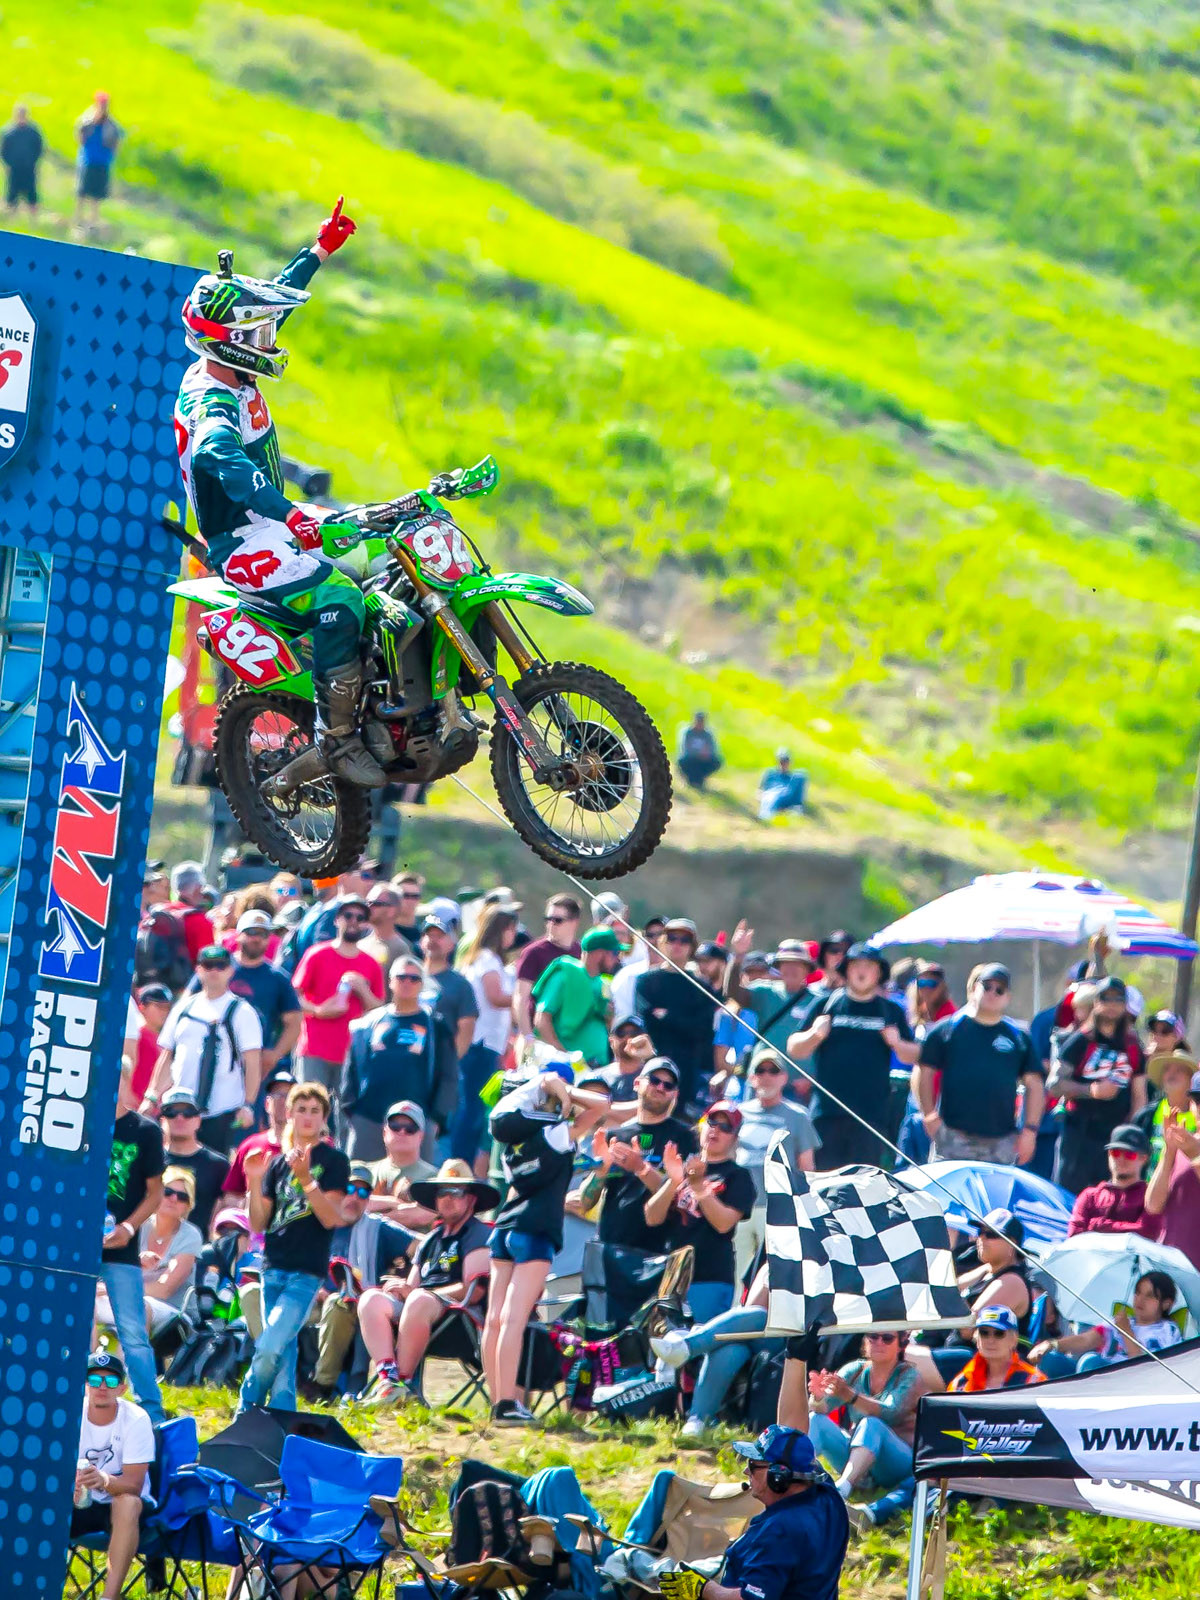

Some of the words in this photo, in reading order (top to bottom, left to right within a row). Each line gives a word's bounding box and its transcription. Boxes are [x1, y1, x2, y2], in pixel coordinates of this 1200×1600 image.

[219, 344, 256, 363] MONSTER
[218, 621, 279, 679] 92
[18, 989, 56, 1144] RACING
[41, 993, 98, 1152] PRO
[967, 1419, 1044, 1438] Thunder
[976, 1437, 1033, 1456] Valley
